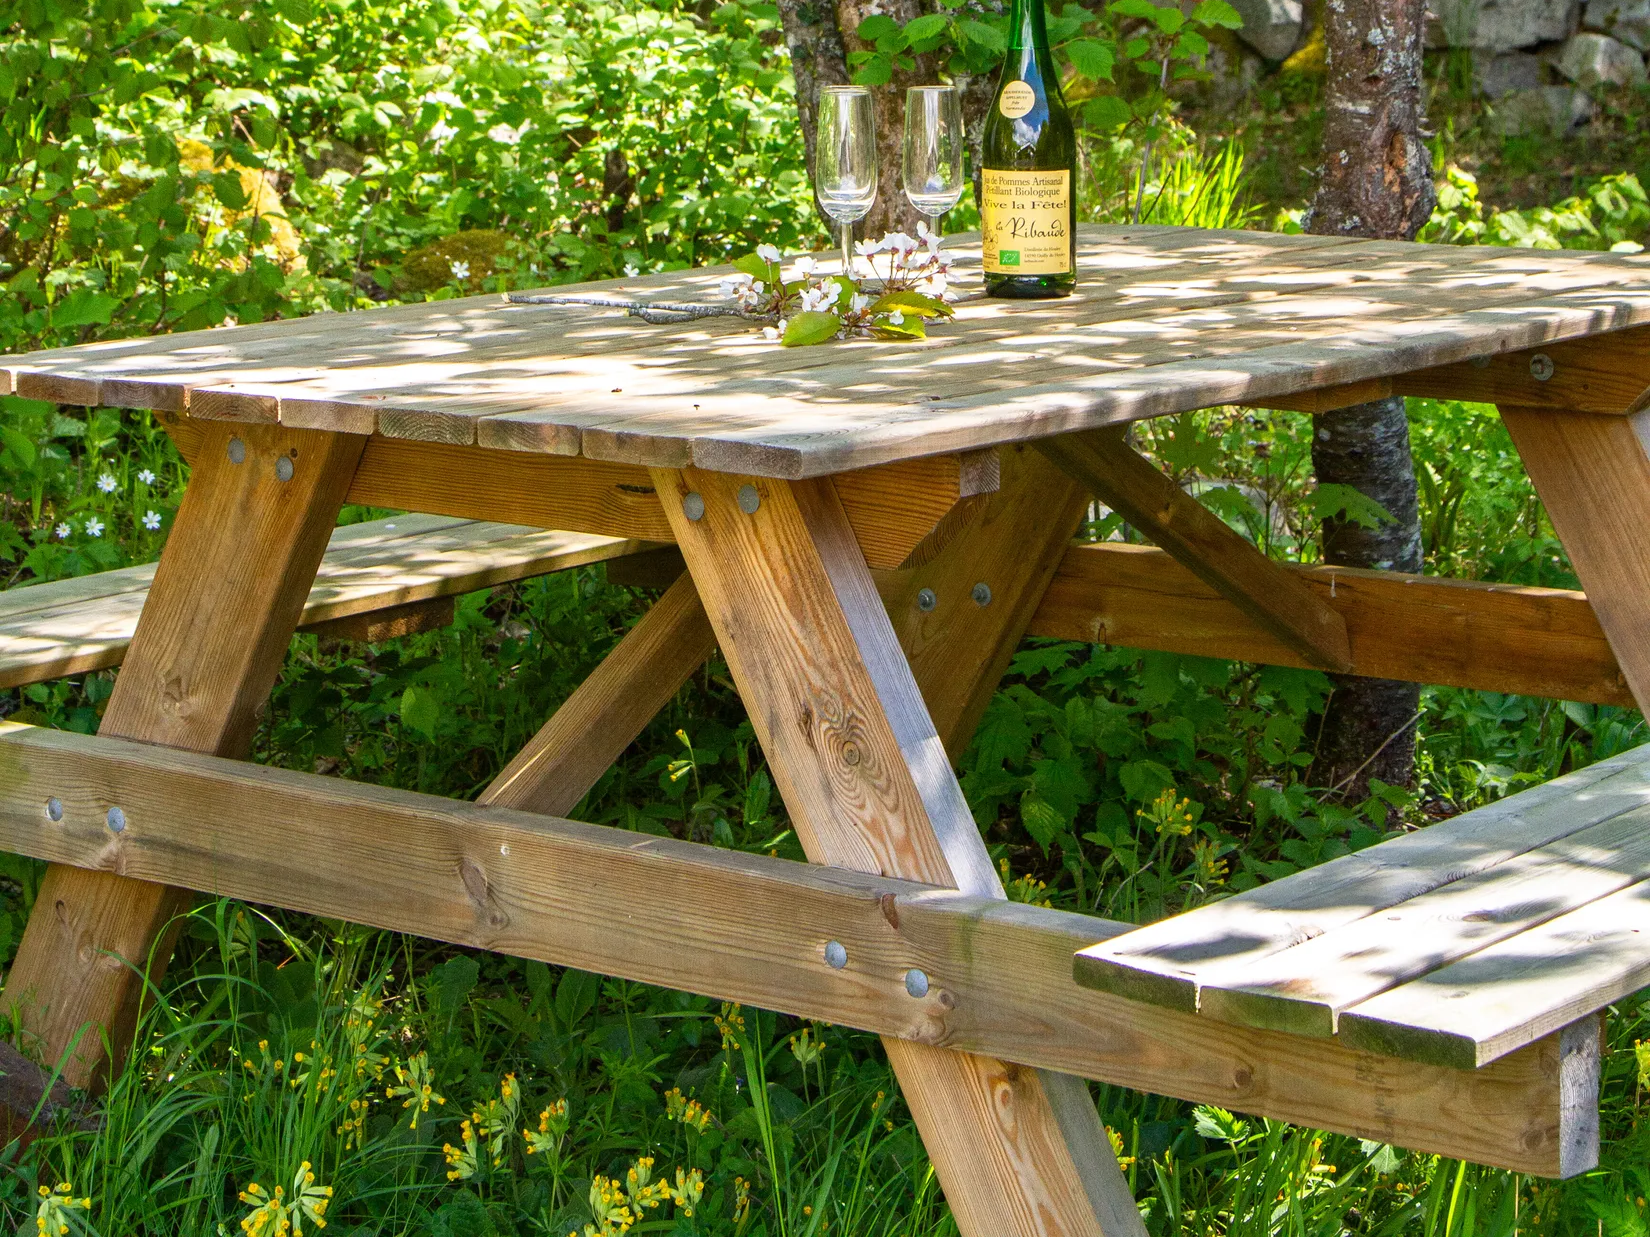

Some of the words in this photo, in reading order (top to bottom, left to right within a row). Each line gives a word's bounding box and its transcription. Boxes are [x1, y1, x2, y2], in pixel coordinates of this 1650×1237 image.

[990, 176, 998, 184] de
[998, 176, 1030, 186] Pommes
[1032, 176, 1064, 186] Artisanal
[986, 185, 1012, 196] Pétillant
[1015, 187, 1060, 198] Biologique
[984, 198, 1007, 208] Vive
[1012, 201, 1026, 210] la
[1032, 200, 1067, 210] Fête!
[1005, 216, 1066, 239] Ribaude
